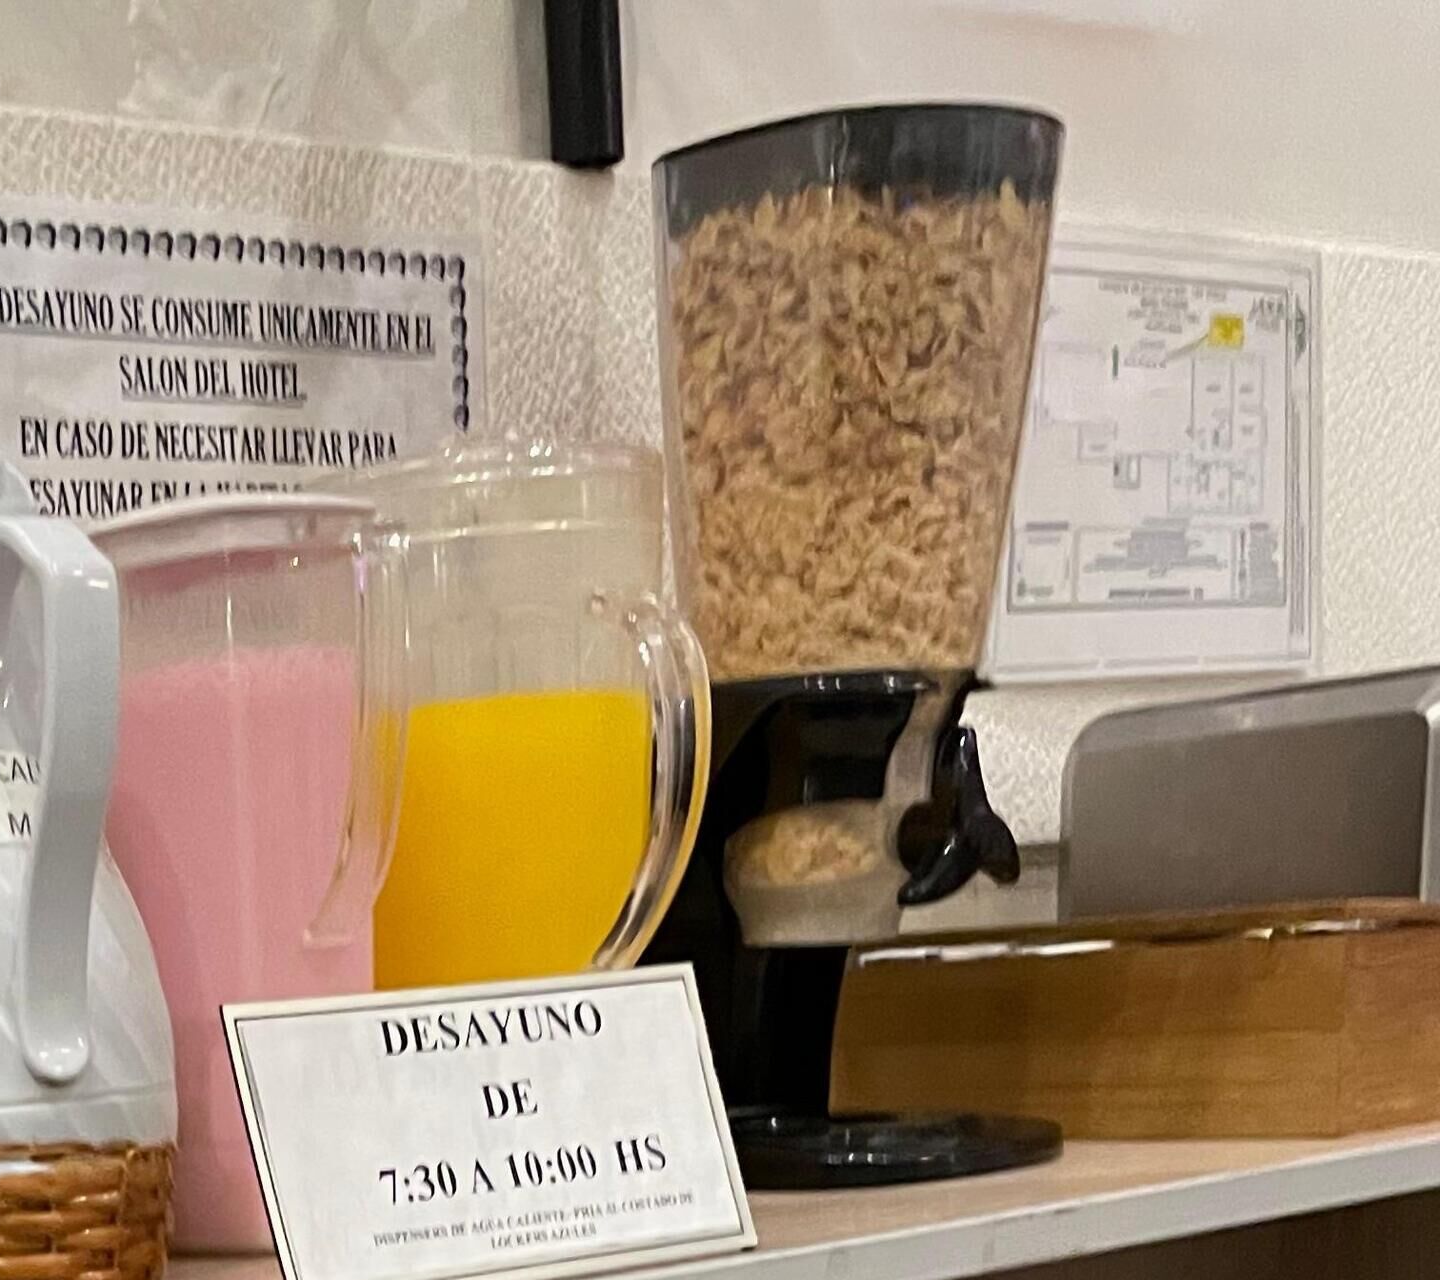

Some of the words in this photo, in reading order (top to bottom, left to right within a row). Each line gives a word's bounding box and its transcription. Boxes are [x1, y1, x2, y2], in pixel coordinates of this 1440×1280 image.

[120, 293, 147, 337] SE
[151, 296, 252, 341] CONSUME
[258, 301, 382, 352] UNICAMENTE
[386, 312, 410, 351] EN
[415, 314, 436, 353] EL
[118, 353, 189, 398] SALON
[194, 358, 236, 398] DEL
[20, 416, 49, 459] EN
[55, 418, 114, 460] CASO
[120, 419, 151, 461] DE
[155, 420, 267, 464] NECESITAR
[271, 424, 345, 468] LLEVAR
[348, 429, 398, 470] PARA
[380, 999, 603, 1057] DESAYUNO
[481, 1077, 539, 1121] DE
[378, 1160, 458, 1207] 7:30
[471, 1157, 496, 1196] A
[503, 1143, 598, 1190] 10:00
[614, 1132, 667, 1176] HS
[450, 1220, 466, 1237] DE
[470, 1216, 505, 1234] AGUA
[489, 1228, 548, 1250] LOCKERS
